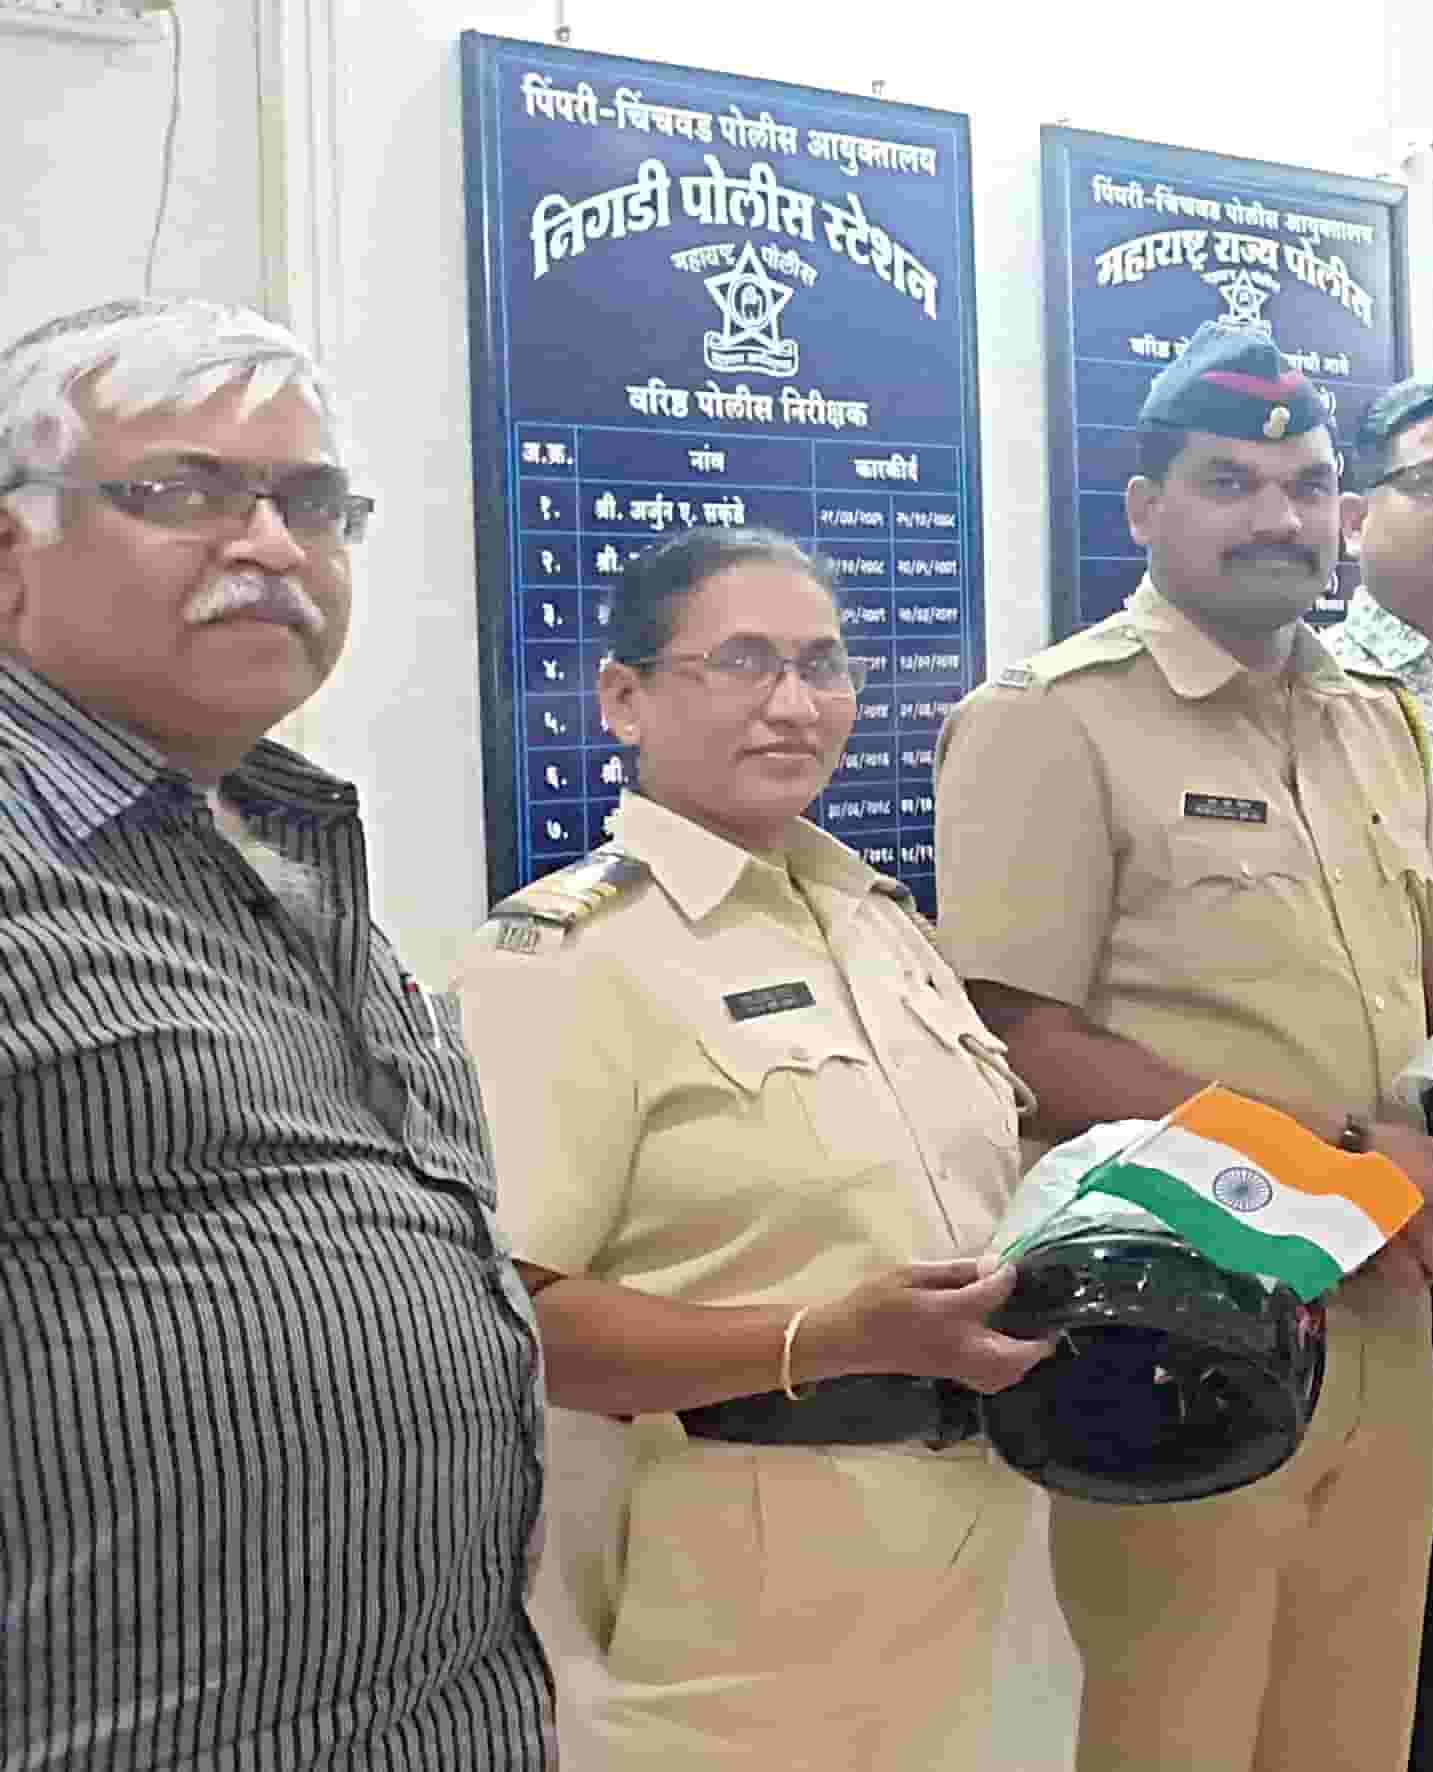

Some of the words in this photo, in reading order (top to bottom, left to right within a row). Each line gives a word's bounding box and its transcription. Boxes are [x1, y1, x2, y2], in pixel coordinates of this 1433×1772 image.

[521, 74, 712, 142] पिंपरी-चिंचवड
[719, 105, 797, 152] पोलीस
[807, 132, 937, 176] आयुक्तालय
[531, 158, 671, 279] निगडी
[680, 155, 815, 240] पोलीस
[822, 193, 937, 320] स्टेशन
[1224, 195, 1280, 231] पोलीस
[1095, 229, 1208, 288] महाराष्ट्र
[1212, 230, 1281, 272] राज्य
[1283, 235, 1374, 328] पोलीस
[625, 377, 689, 418] वरिष्ठ
[694, 379, 773, 423] पोलीस
[778, 385, 870, 430] निरीक्षक
[594, 490, 624, 520] श्री.
